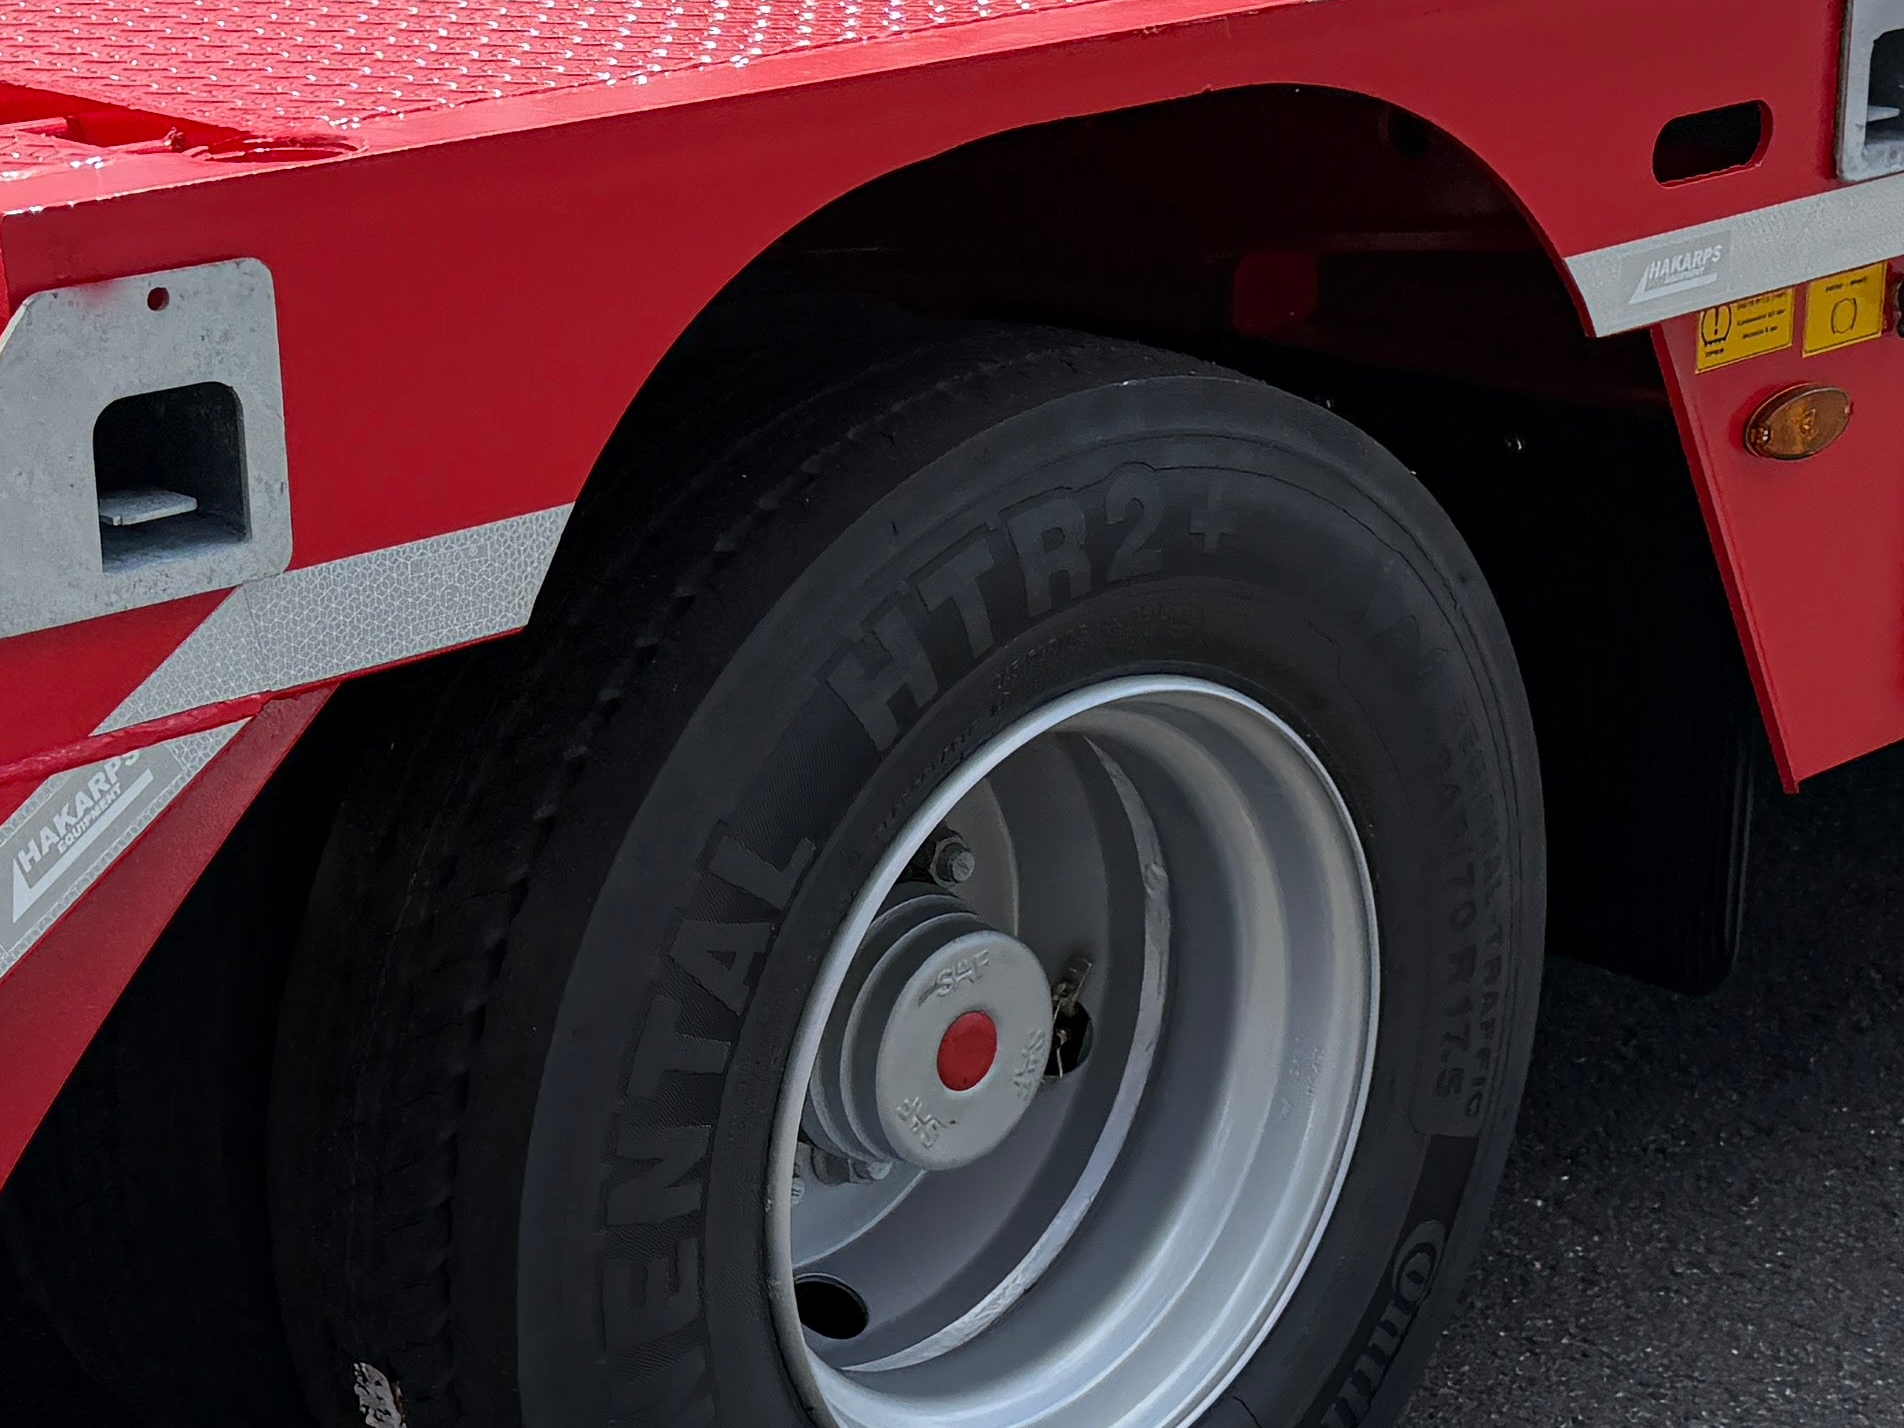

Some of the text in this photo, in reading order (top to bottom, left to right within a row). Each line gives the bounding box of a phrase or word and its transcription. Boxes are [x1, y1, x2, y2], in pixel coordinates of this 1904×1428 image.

[1649, 245, 1723, 275] HAKARPS
[18, 748, 143, 874] HAKARPS
[56, 783, 124, 854] EQUIPMENT
[936, 949, 991, 998] SAF
